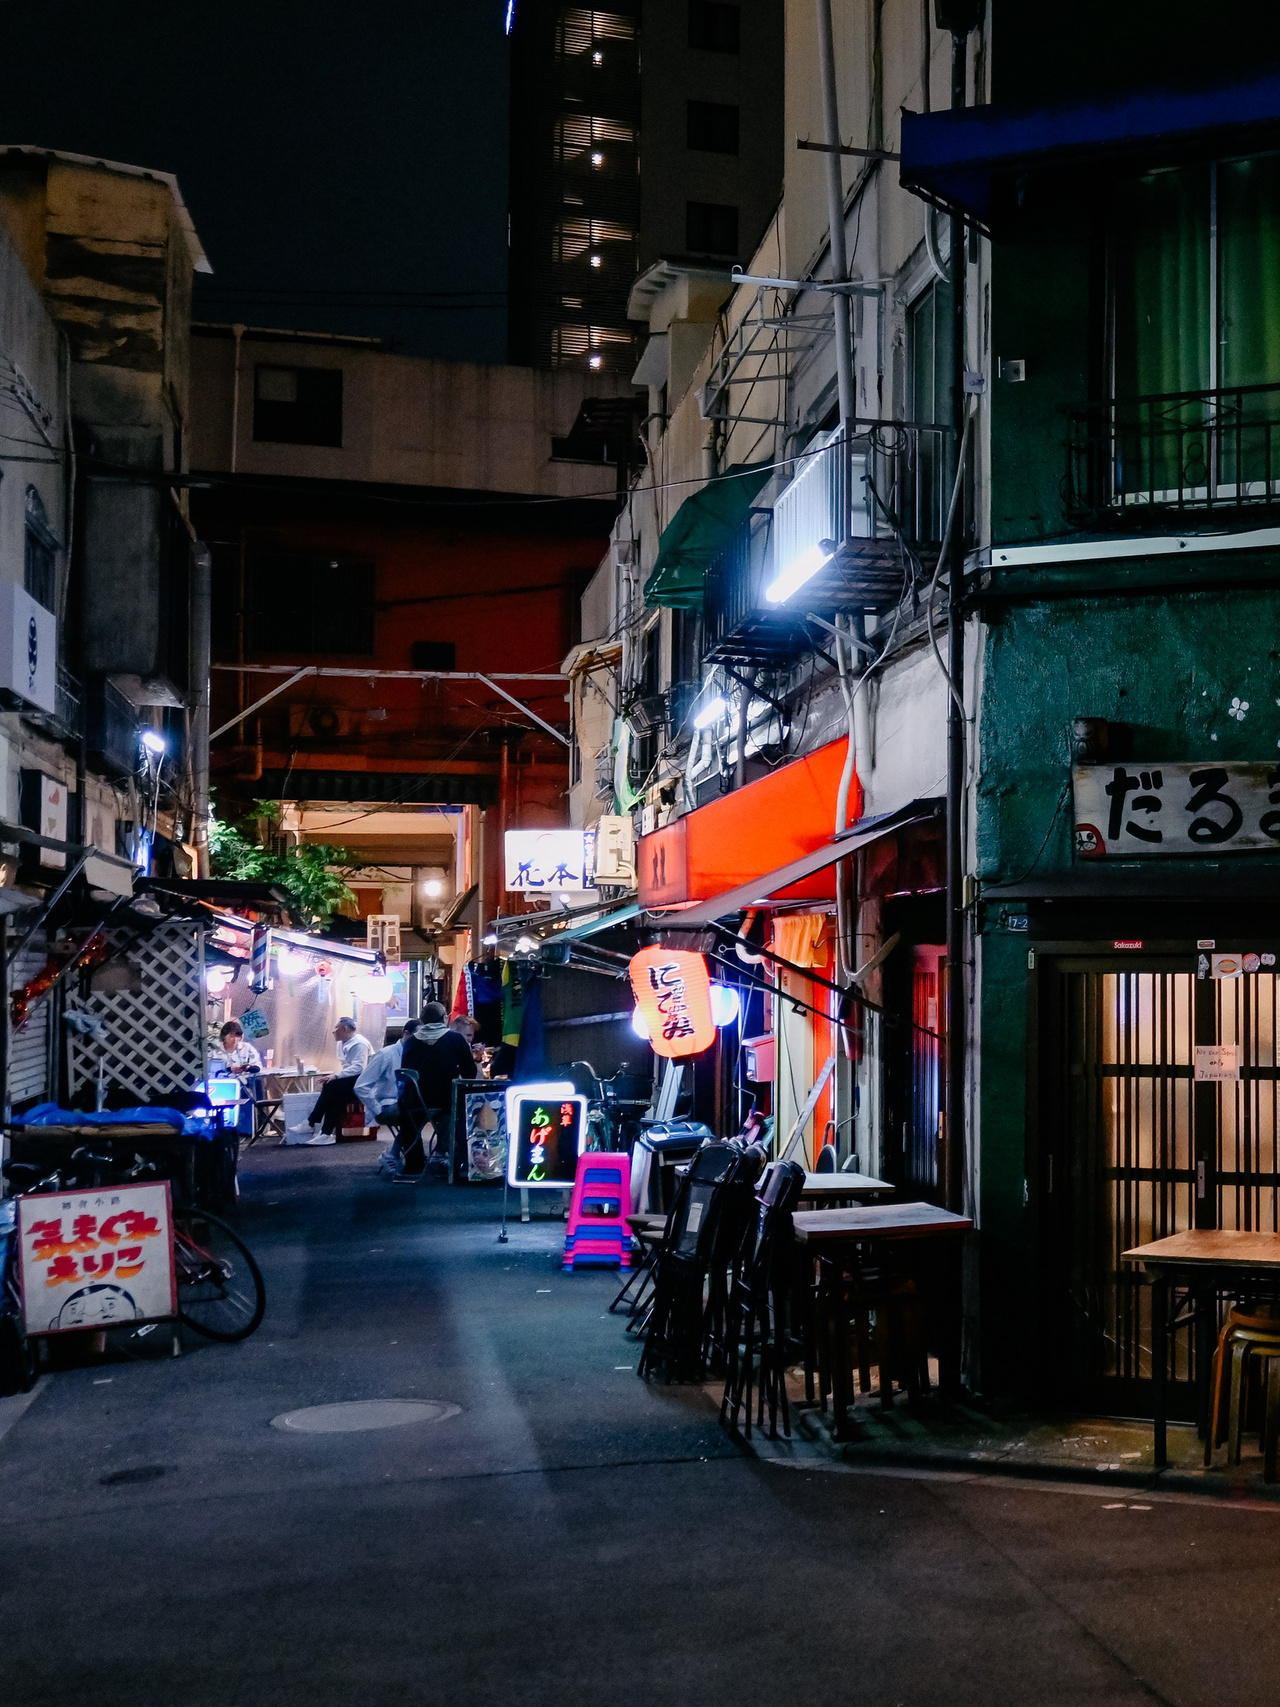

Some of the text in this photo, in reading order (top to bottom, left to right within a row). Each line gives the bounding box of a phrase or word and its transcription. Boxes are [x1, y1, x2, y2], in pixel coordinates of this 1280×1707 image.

[1114, 941, 1142, 949] Sakazuki
[46, 1246, 145, 1287] えりこ
